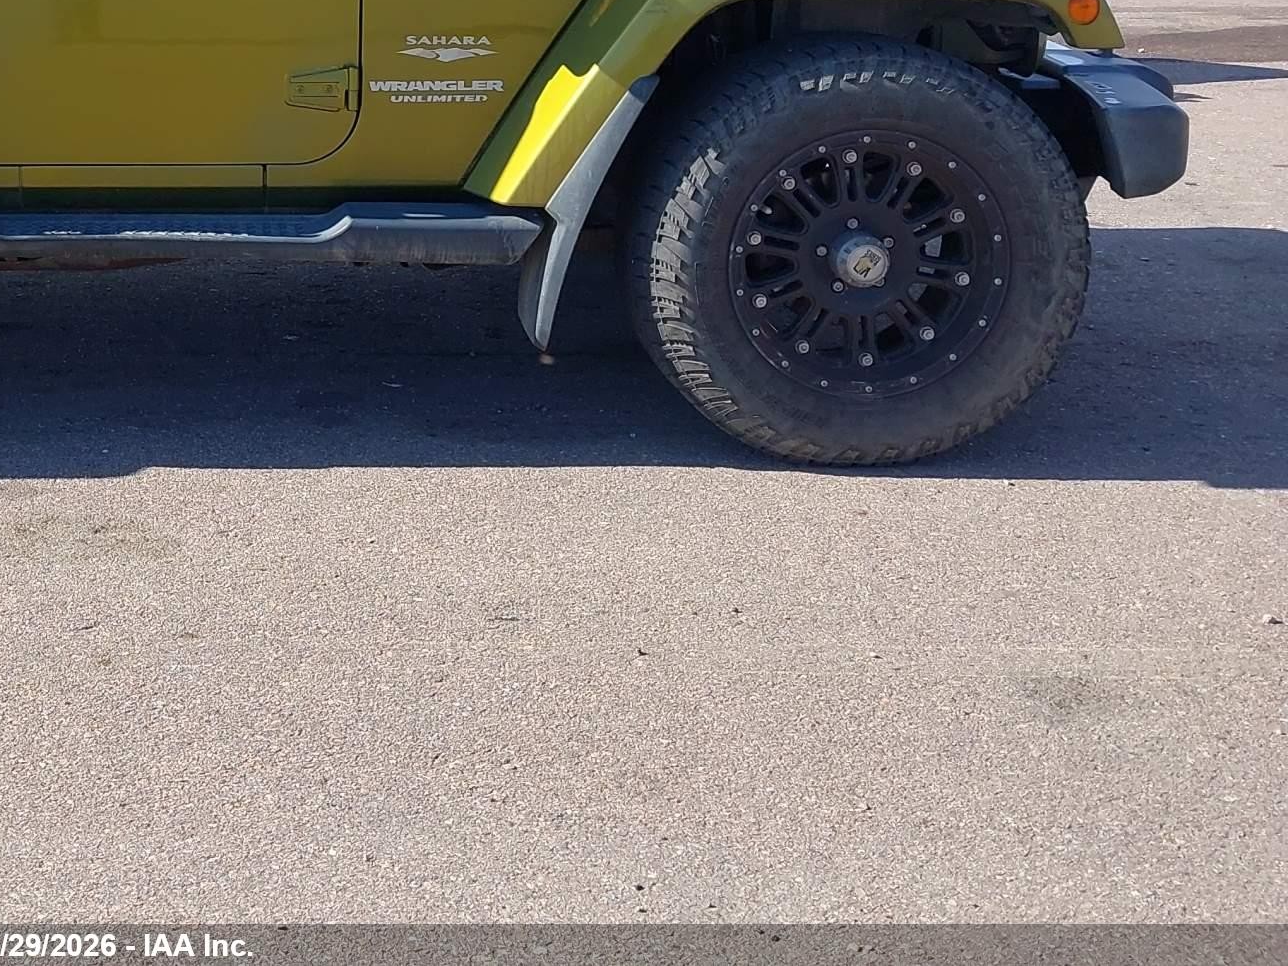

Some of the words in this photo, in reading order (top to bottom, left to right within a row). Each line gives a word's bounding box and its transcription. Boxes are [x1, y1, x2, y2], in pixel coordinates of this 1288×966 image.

[405, 35, 492, 46] SAHARA
[368, 80, 504, 92] WRANGLER
[390, 94, 488, 103] UNLIMITED
